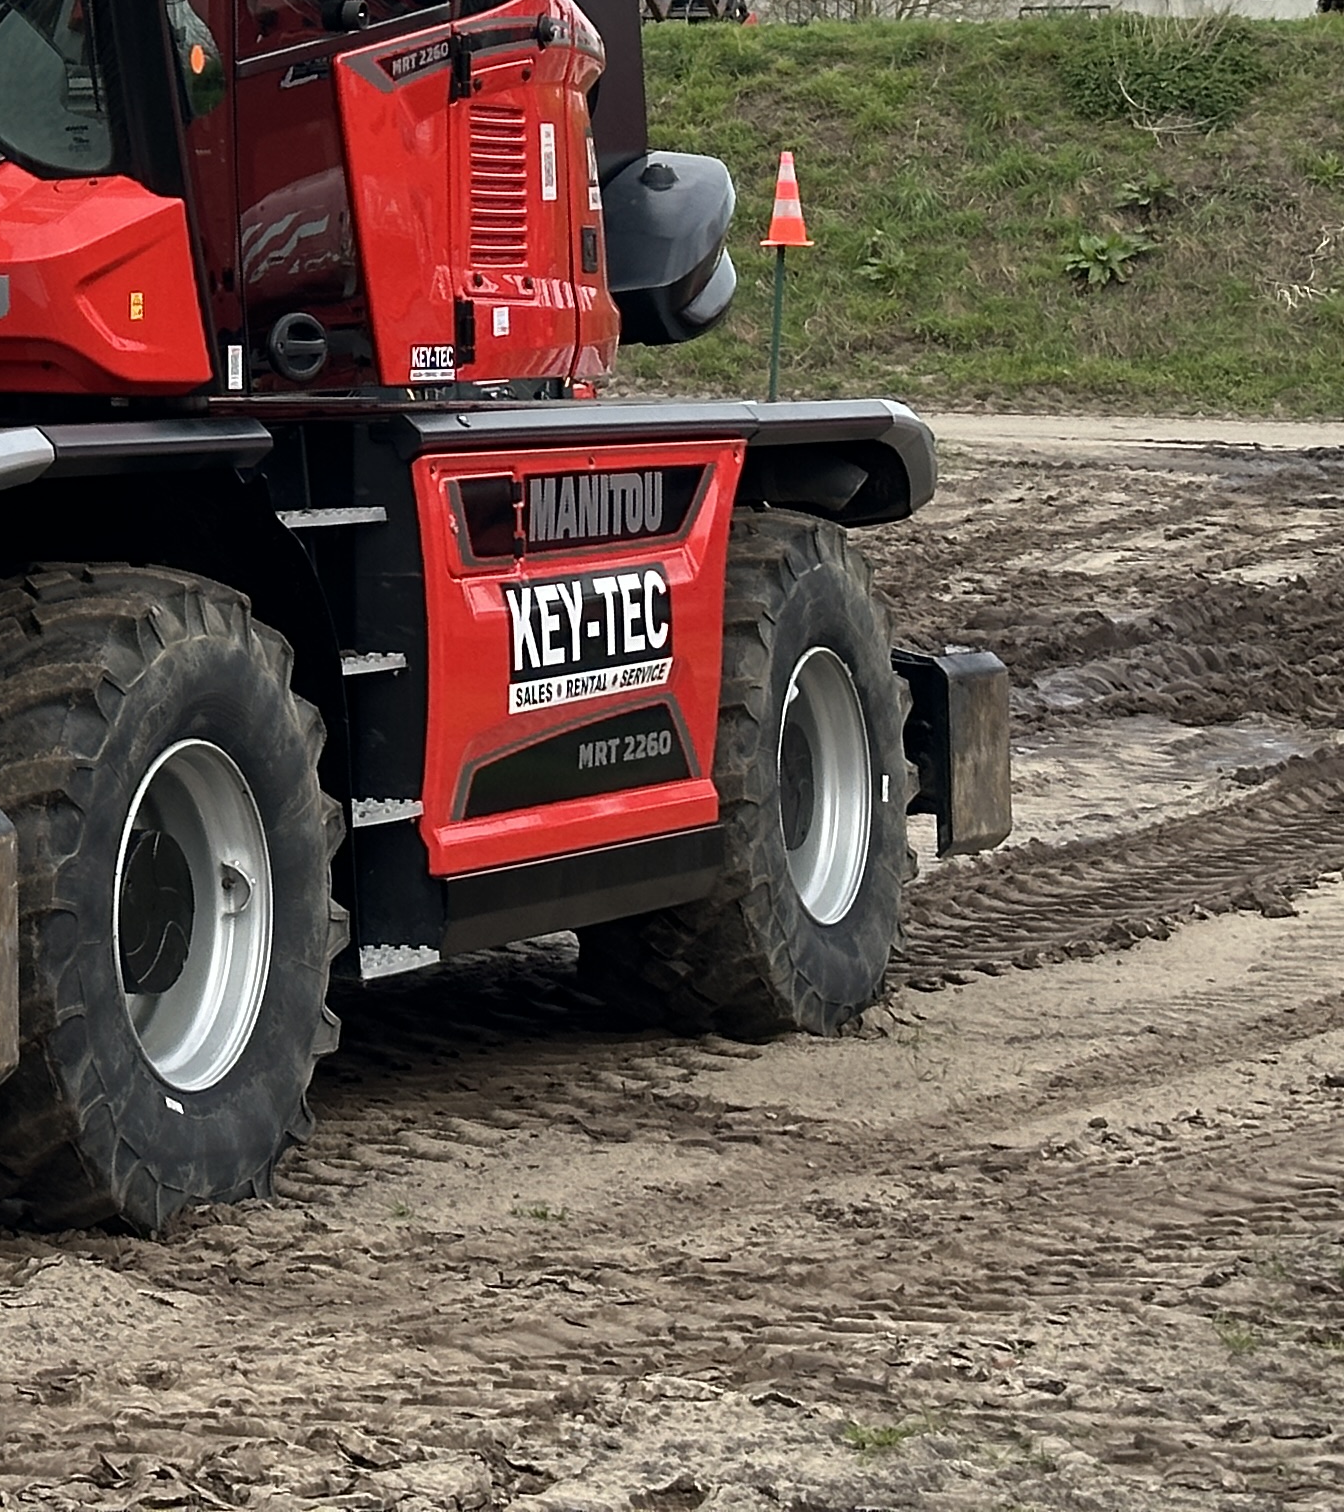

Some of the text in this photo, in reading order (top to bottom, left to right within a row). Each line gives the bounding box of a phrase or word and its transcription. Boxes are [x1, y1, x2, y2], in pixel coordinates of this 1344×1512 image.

[392, 41, 449, 76] MRT 2260
[412, 346, 454, 368] KEY-TEC
[529, 471, 663, 542] MANITOU
[506, 569, 669, 671] KEY-TEC
[515, 661, 667, 707] SALES RENTAL SERVICE
[578, 730, 672, 770] MRT 2260
